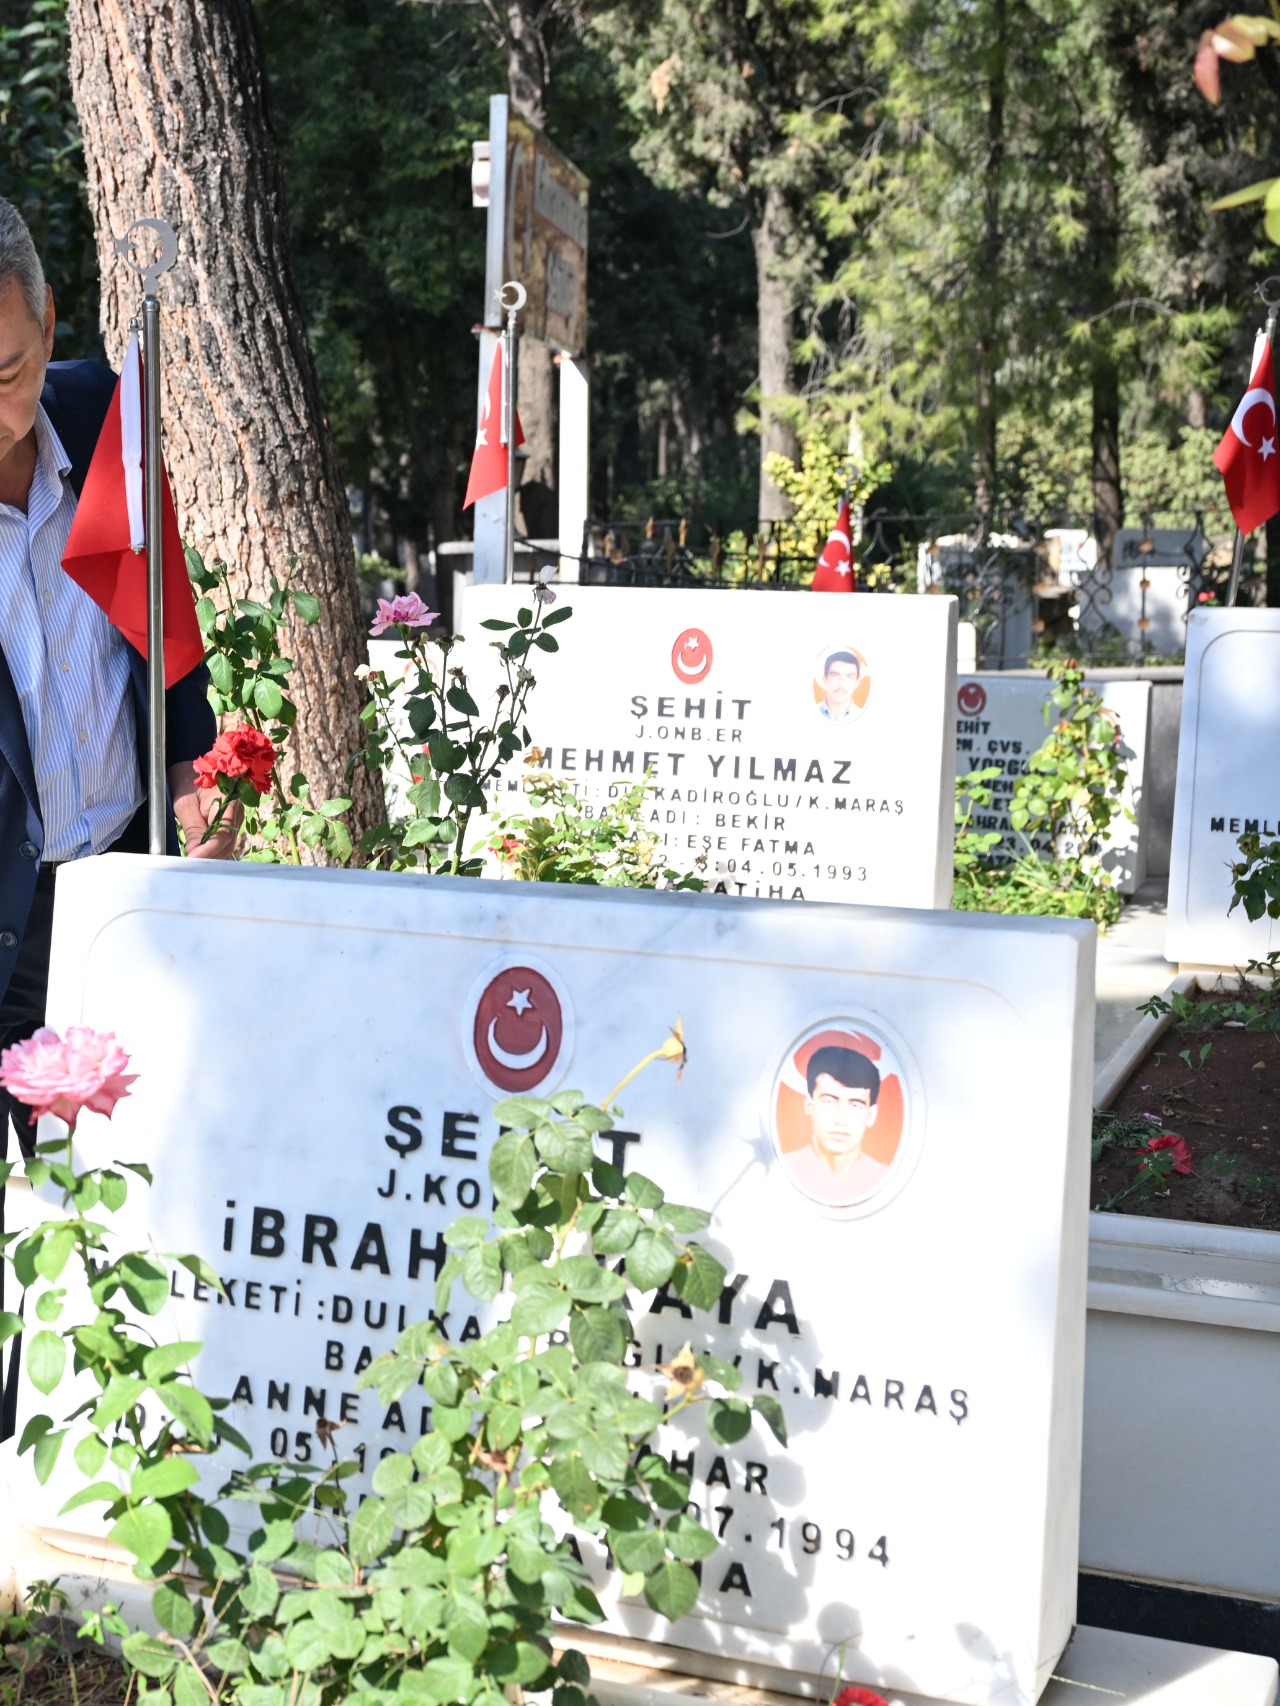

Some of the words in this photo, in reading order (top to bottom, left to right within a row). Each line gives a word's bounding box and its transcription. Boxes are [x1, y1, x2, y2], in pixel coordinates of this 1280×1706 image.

[630, 691, 752, 720] ŞEHİT
[956, 718, 991, 735] EHİT
[708, 754, 852, 785] YILMAZ
[1210, 817, 1280, 836] MEML
[741, 838, 815, 856] FATMA
[702, 880, 807, 900] ATİHA
[384, 1105, 642, 1178] ŞET
[222, 1199, 449, 1283] İBRAH
[231, 1375, 360, 1425] ANNE
